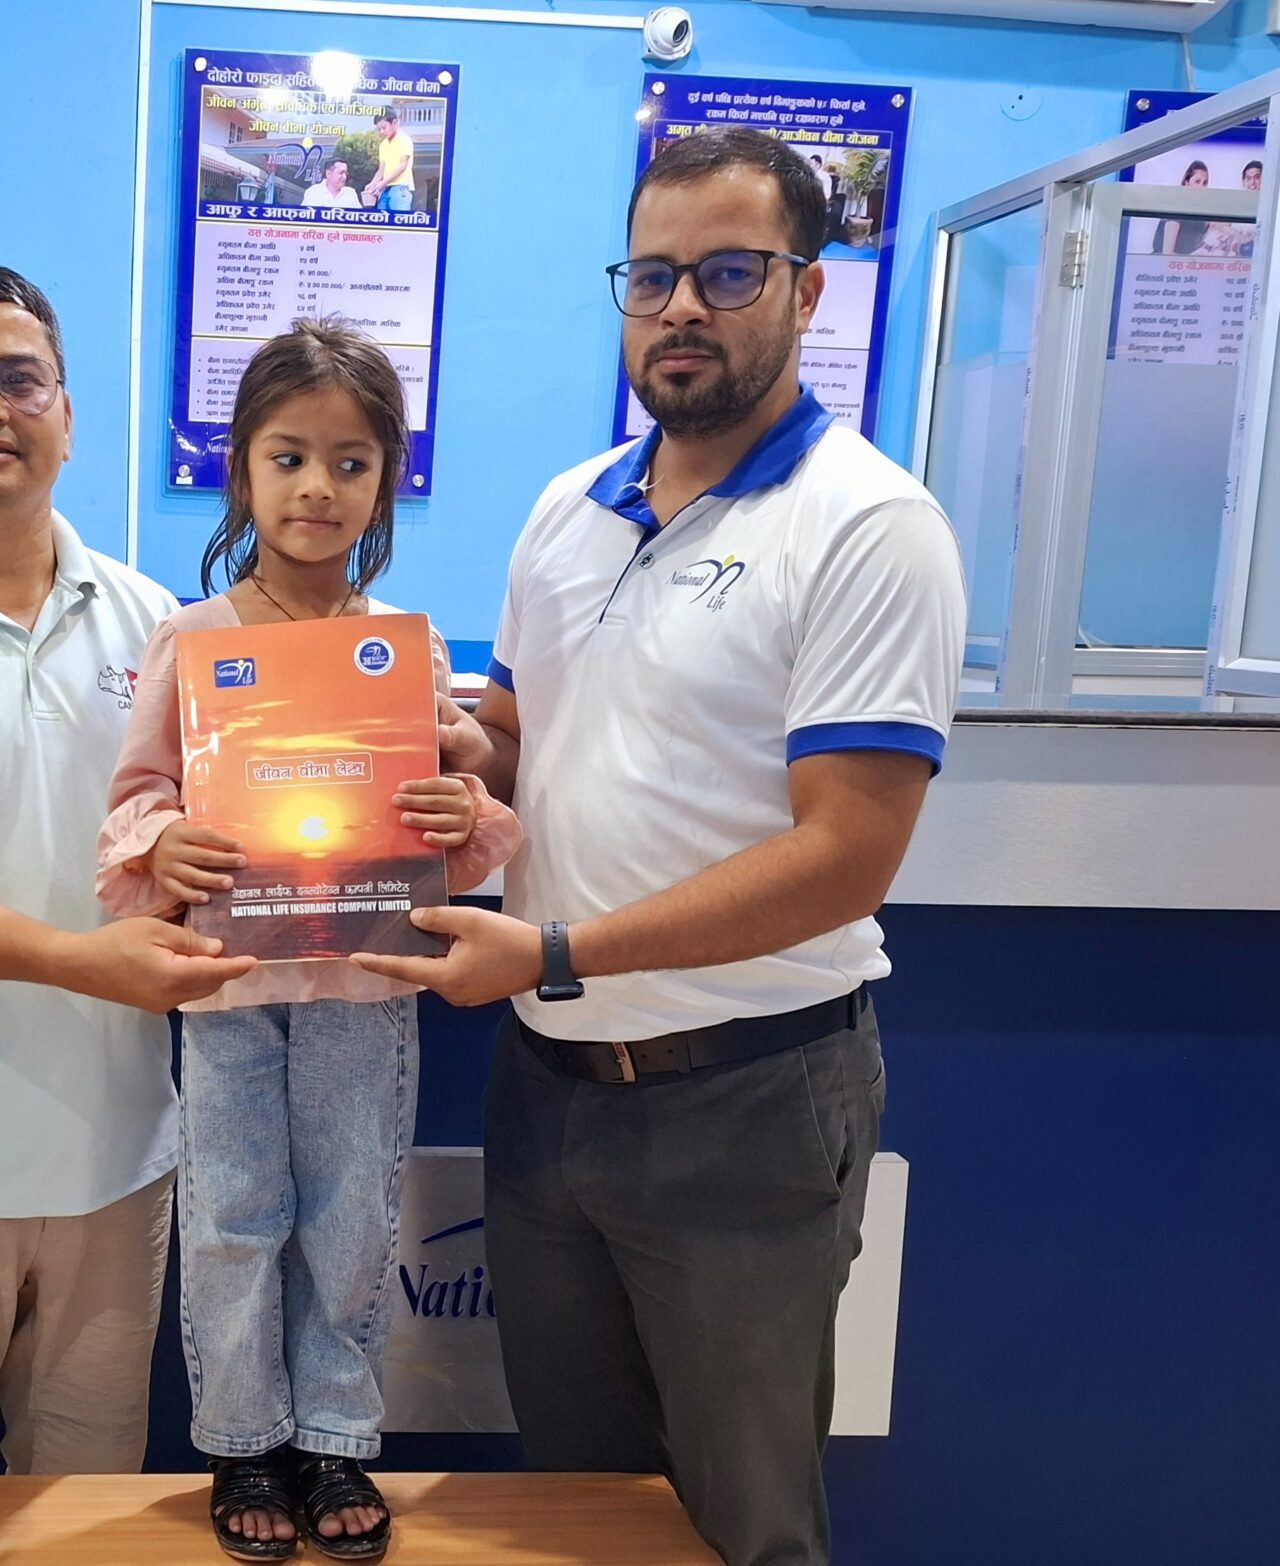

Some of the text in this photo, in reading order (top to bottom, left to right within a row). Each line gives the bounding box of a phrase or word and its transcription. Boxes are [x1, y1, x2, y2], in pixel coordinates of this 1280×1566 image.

[207, 68, 243, 83] दोहोरो
[246, 72, 282, 87] फाइदा
[286, 72, 320, 88] सहित
[382, 75, 413, 92] जीवन
[416, 77, 441, 94] बीमा
[206, 95, 236, 110] जीवन
[249, 119, 346, 136] जीवन बीमा योजना
[822, 130, 844, 144] बीमा
[846, 131, 879, 145] योजना
[247, 206, 258, 218] र
[321, 208, 389, 224] परिवारको
[394, 211, 431, 226] लागि
[666, 571, 726, 613] National Life
[254, 763, 293, 781] जीवन
[334, 758, 365, 776] लेख
[231, 899, 411, 917] NATIONAL LIFE INSURANCE COMPANY LIMITED
